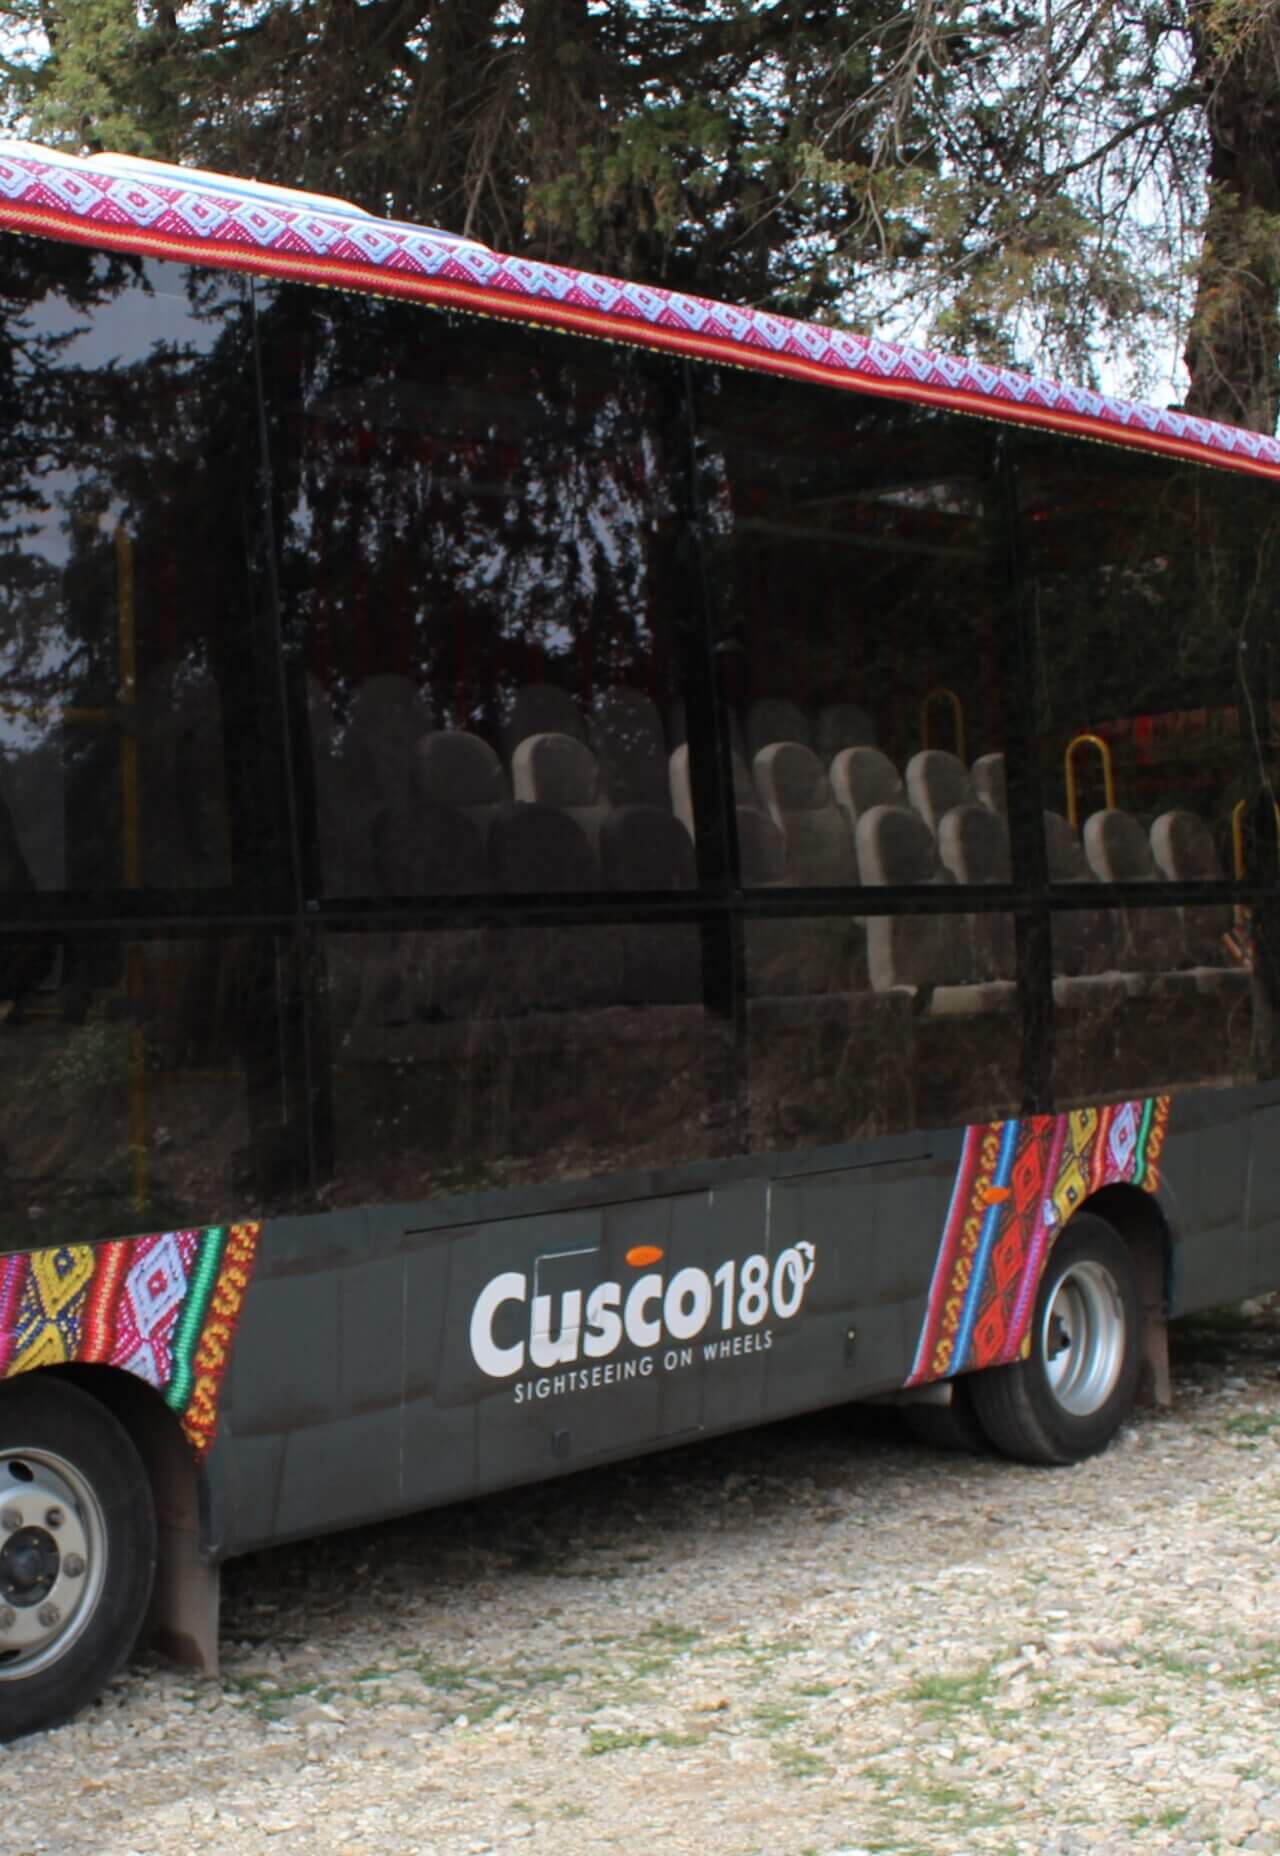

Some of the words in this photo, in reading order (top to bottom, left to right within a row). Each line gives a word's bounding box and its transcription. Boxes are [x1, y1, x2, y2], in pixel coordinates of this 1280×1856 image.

[514, 1356, 653, 1403] SIGHTSEEING
[663, 1347, 693, 1371] ON
[703, 1330, 773, 1361] WHEELS
